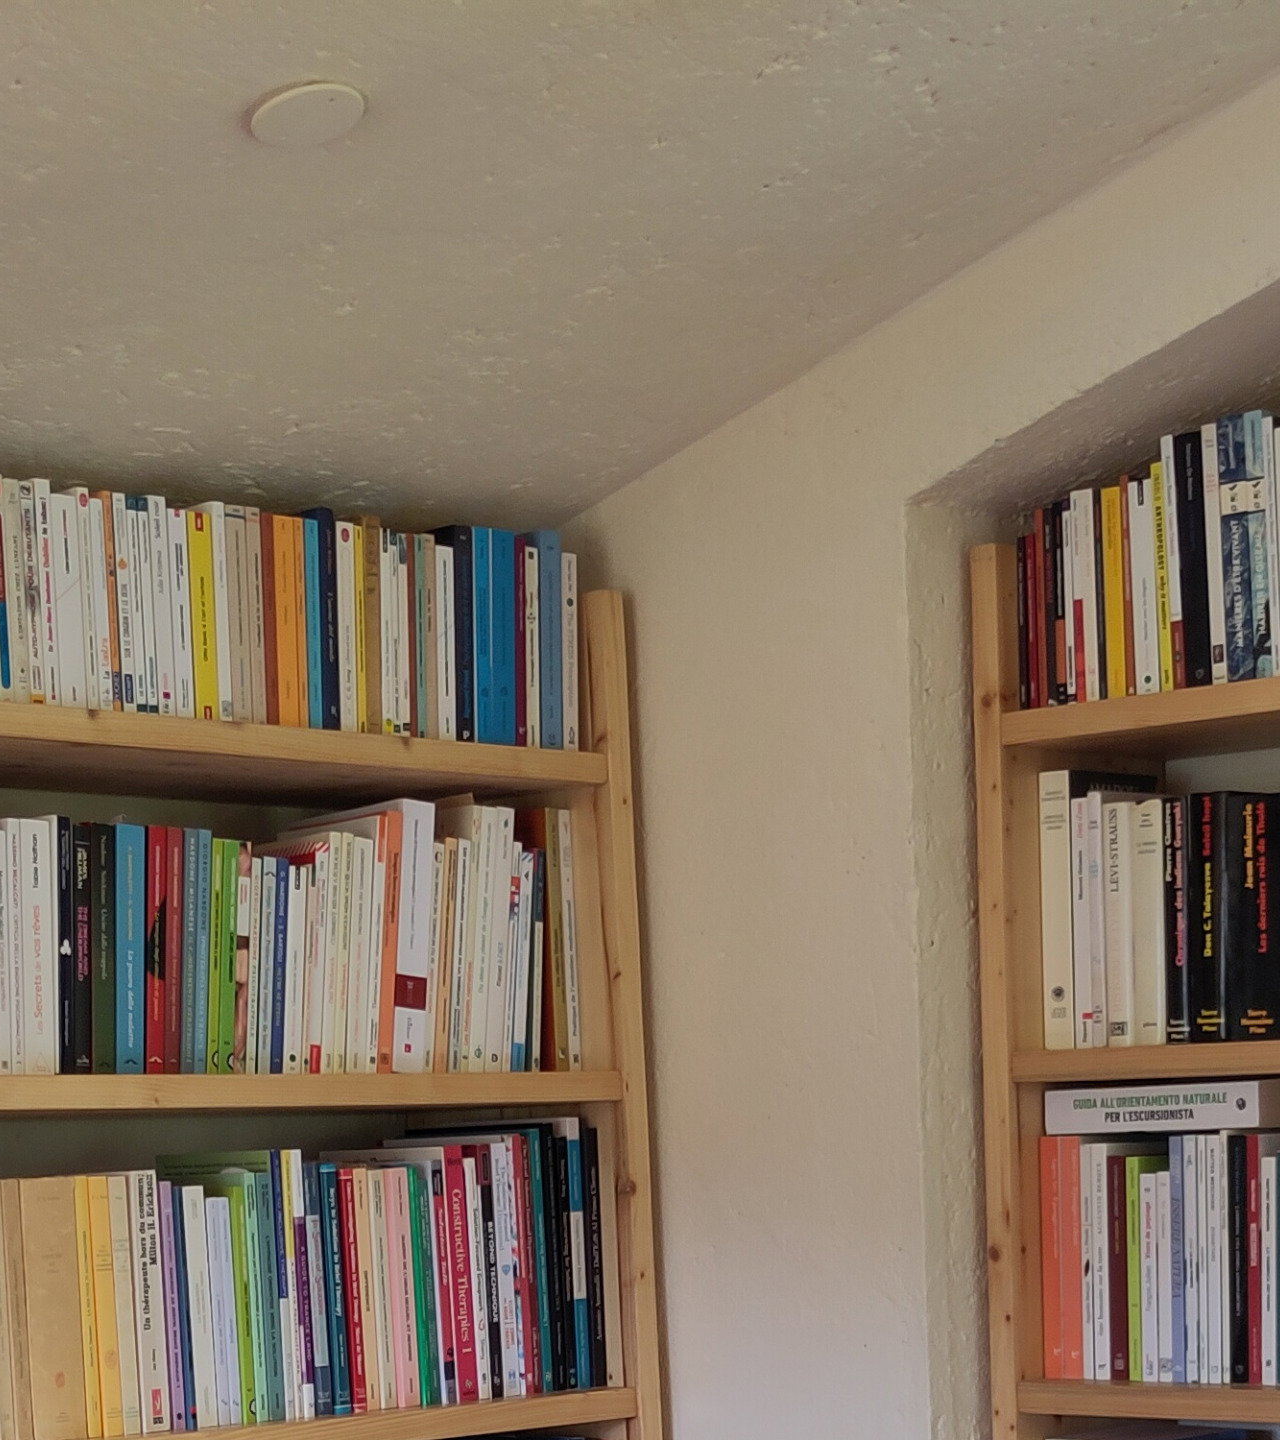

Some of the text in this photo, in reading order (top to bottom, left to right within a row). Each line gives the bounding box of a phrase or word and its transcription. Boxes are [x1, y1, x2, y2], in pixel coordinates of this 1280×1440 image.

[1202, 933, 1213, 958] Don
[1072, 1090, 1229, 1111] GUIDA ALL'ORIENTAMENTO NATURALE
[1104, 1107, 1195, 1124] PER L'ESCURSIONISTA
